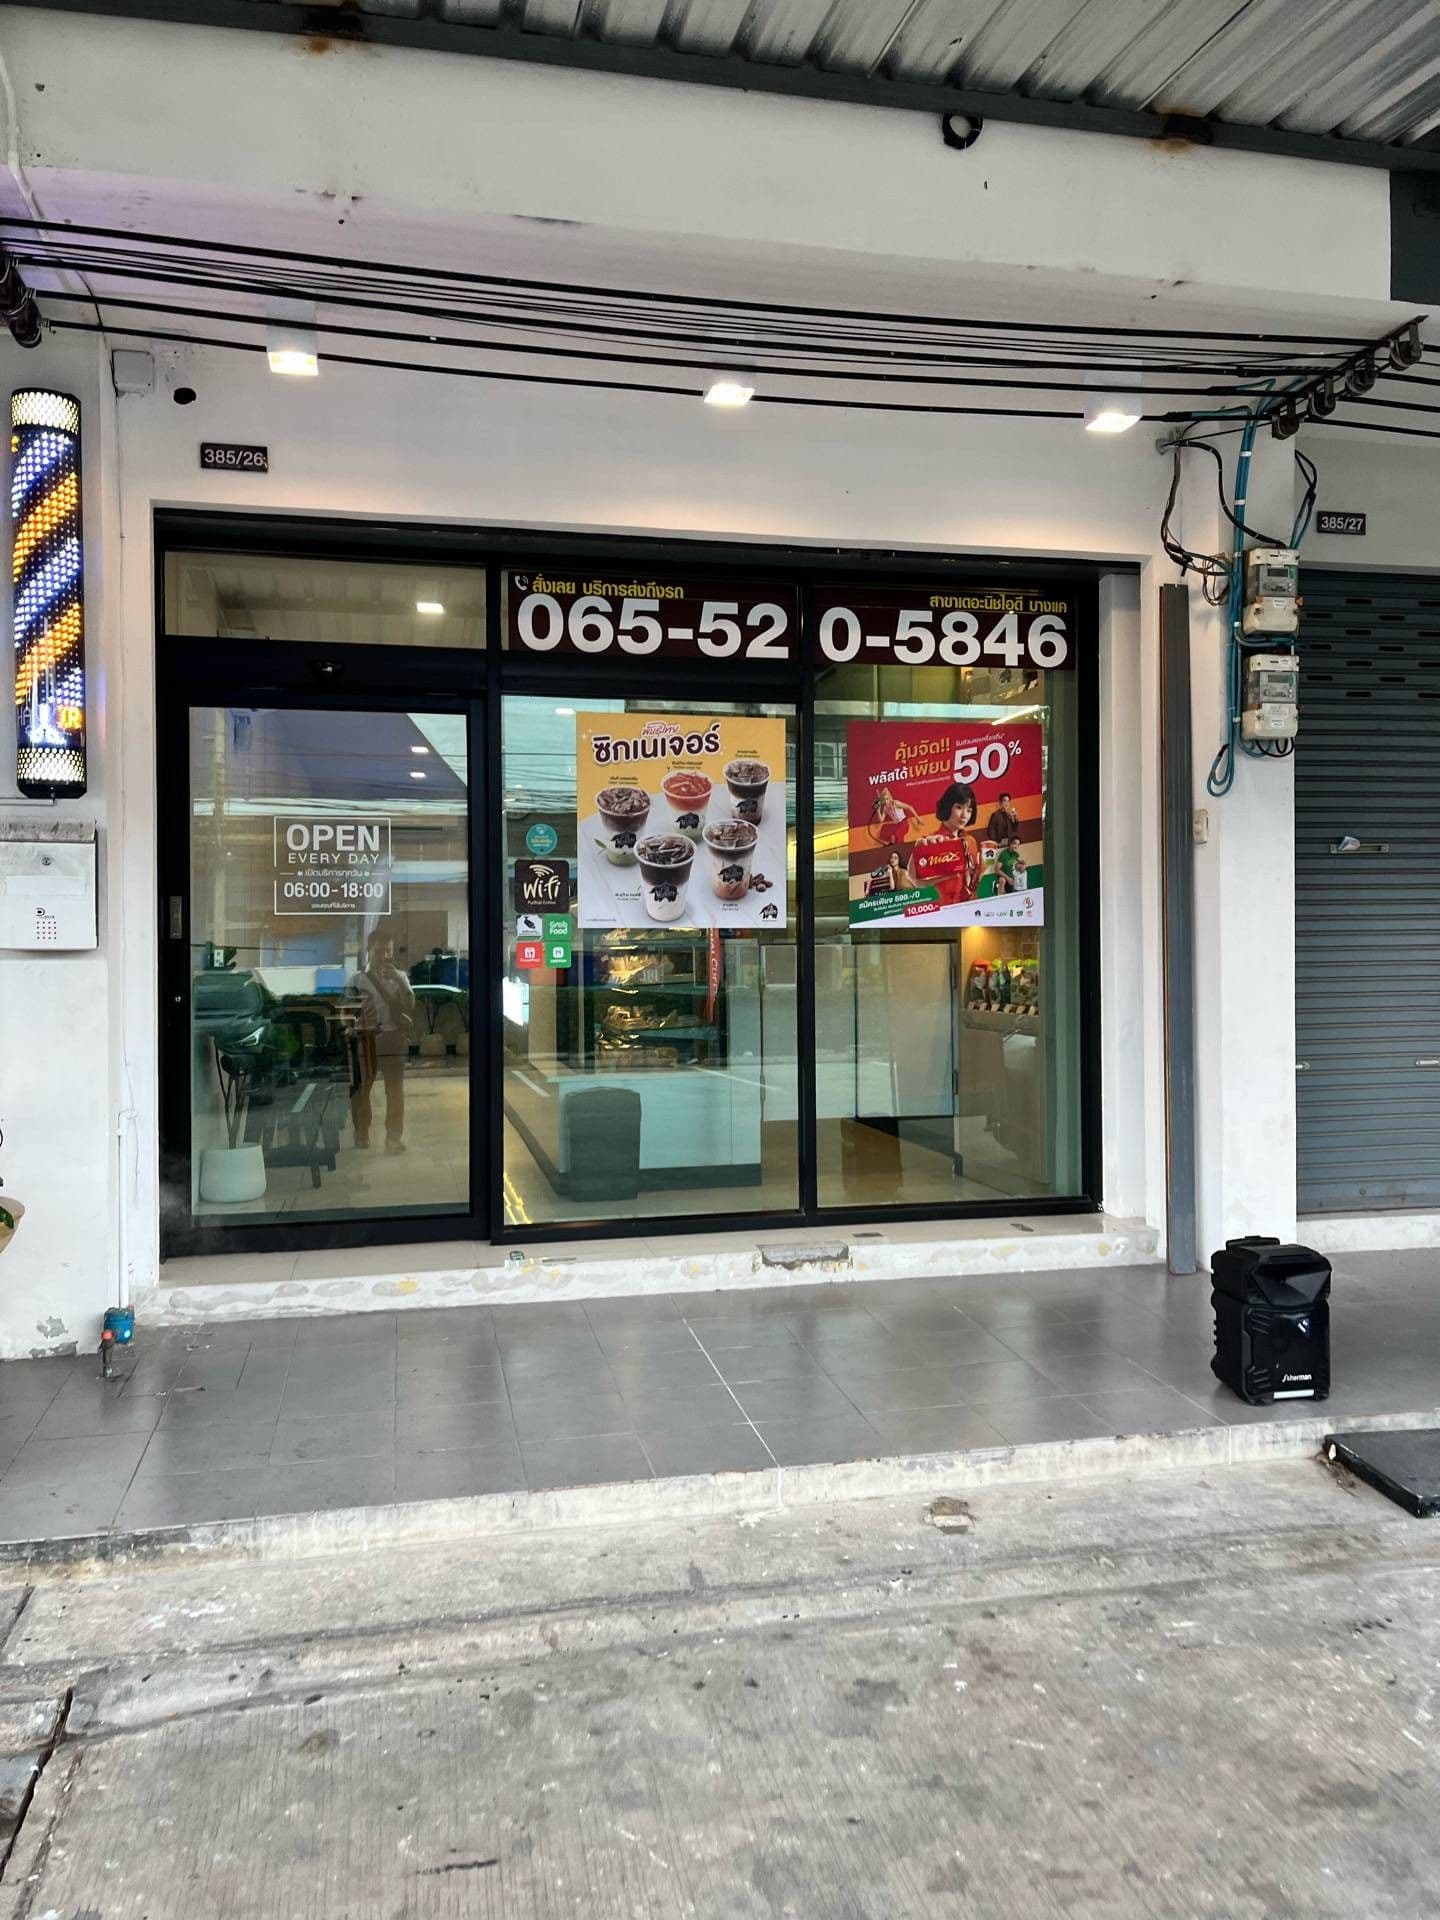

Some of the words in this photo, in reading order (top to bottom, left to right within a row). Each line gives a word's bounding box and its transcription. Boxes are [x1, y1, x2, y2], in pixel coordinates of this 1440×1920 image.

[204, 449, 264, 466] 385/26
[1321, 516, 1364, 530] 385/27
[532, 574, 576, 594] สั่งเลย
[1029, 600, 1067, 613] บางแค
[518, 593, 789, 659] 065-52
[819, 606, 1068, 668] 0-5846
[593, 724, 721, 763] ซิกเนเจอร์
[286, 824, 380, 851] OPEN
[288, 853, 340, 864] EVERY
[348, 853, 380, 864] DAY
